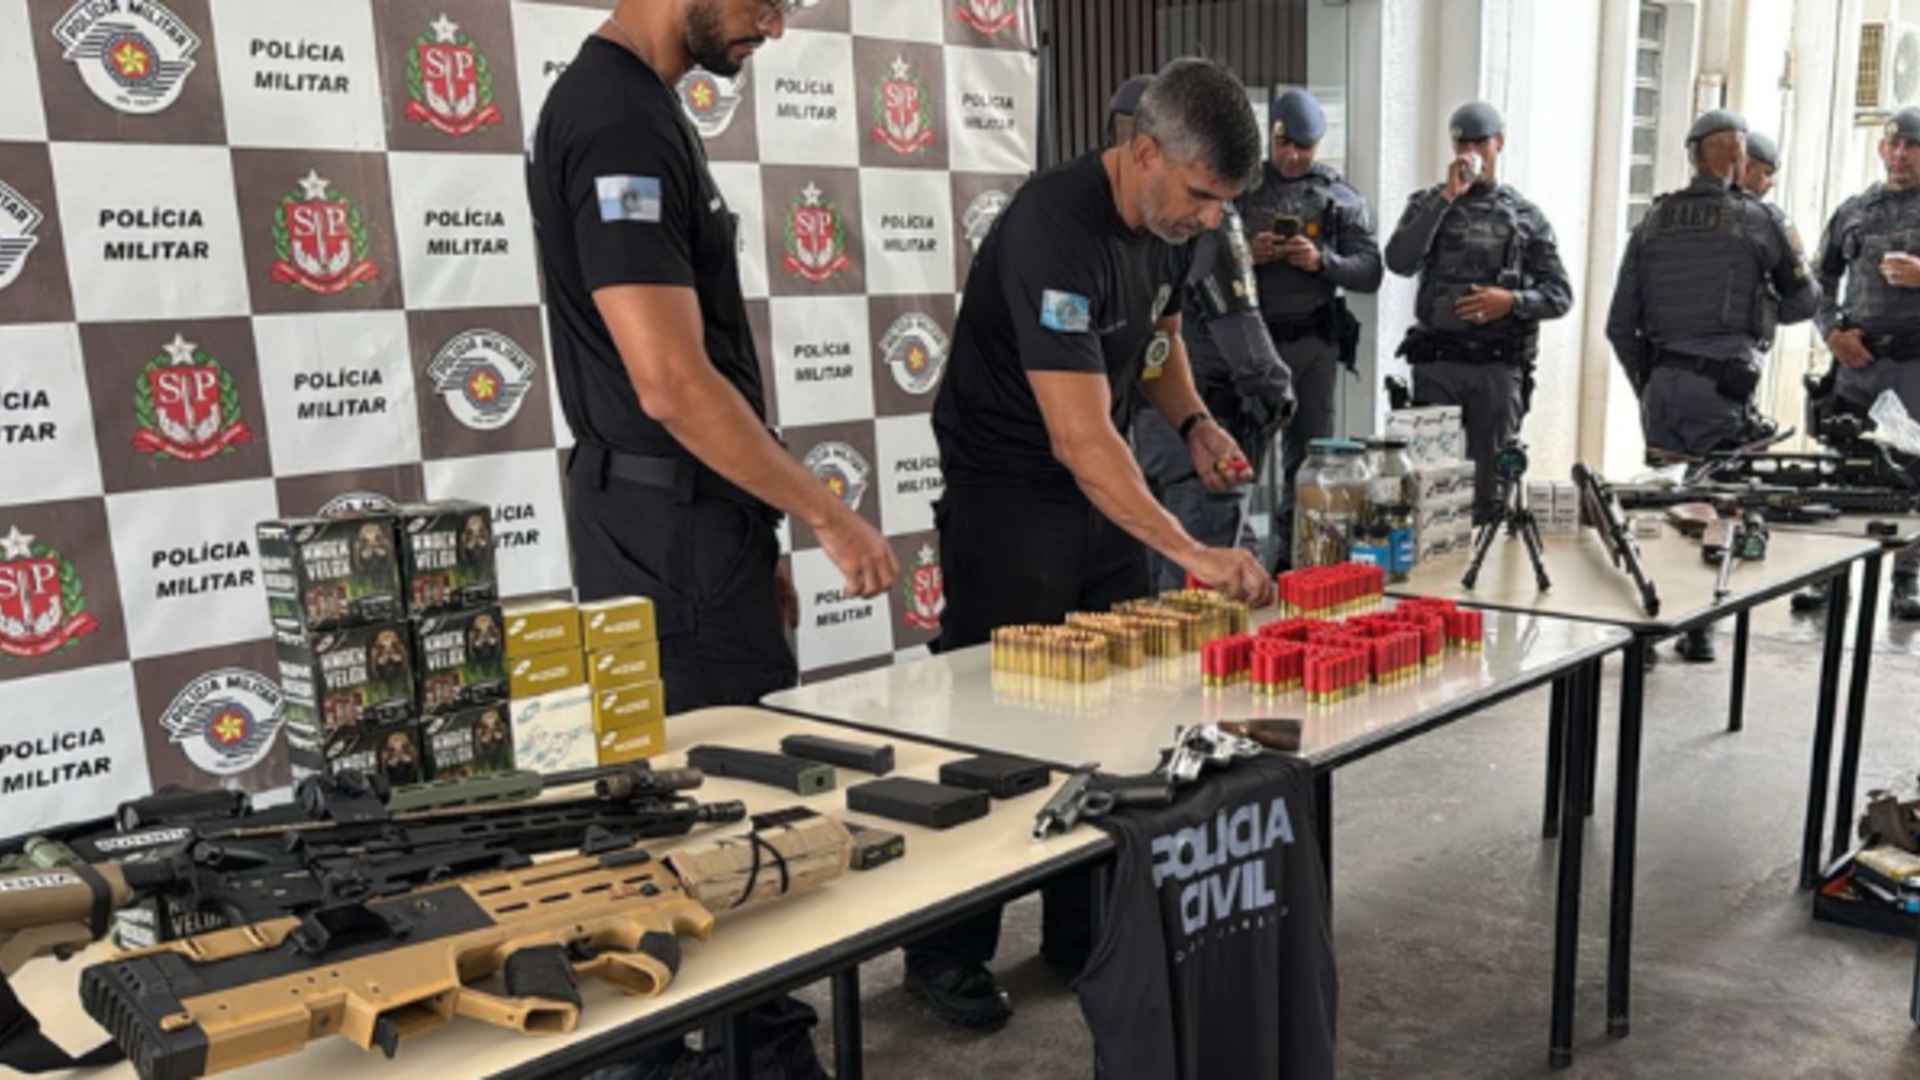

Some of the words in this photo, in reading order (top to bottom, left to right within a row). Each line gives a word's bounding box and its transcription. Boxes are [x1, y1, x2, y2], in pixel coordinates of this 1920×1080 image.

[251, 38, 345, 62] POLÍCIA
[254, 71, 350, 93] MILITAR
[775, 78, 834, 95] POLÍCIA
[777, 103, 837, 120] MILITAR
[99, 206, 203, 228] POLÍCIA
[424, 209, 504, 228] POLÍCIA
[881, 213, 934, 230] POLÍCIA
[104, 241, 209, 261] MILITAR
[427, 238, 508, 255] MILITAR
[884, 238, 936, 251] MILITAR
[794, 340, 850, 358] POLÍCIA
[294, 367, 383, 391] POLÍCIA
[795, 365, 853, 382] MILITAR
[297, 397, 387, 420] MILITAR
[3, 422, 57, 443] TAR
[152, 541, 251, 568] POLÍCIA
[156, 570, 255, 598] MILITAR
[816, 605, 872, 627] MILITAR
[0, 727, 105, 763] POLÍCIA
[2, 757, 112, 794] MILITAR
[1180, 859, 1276, 935] CIVIL
